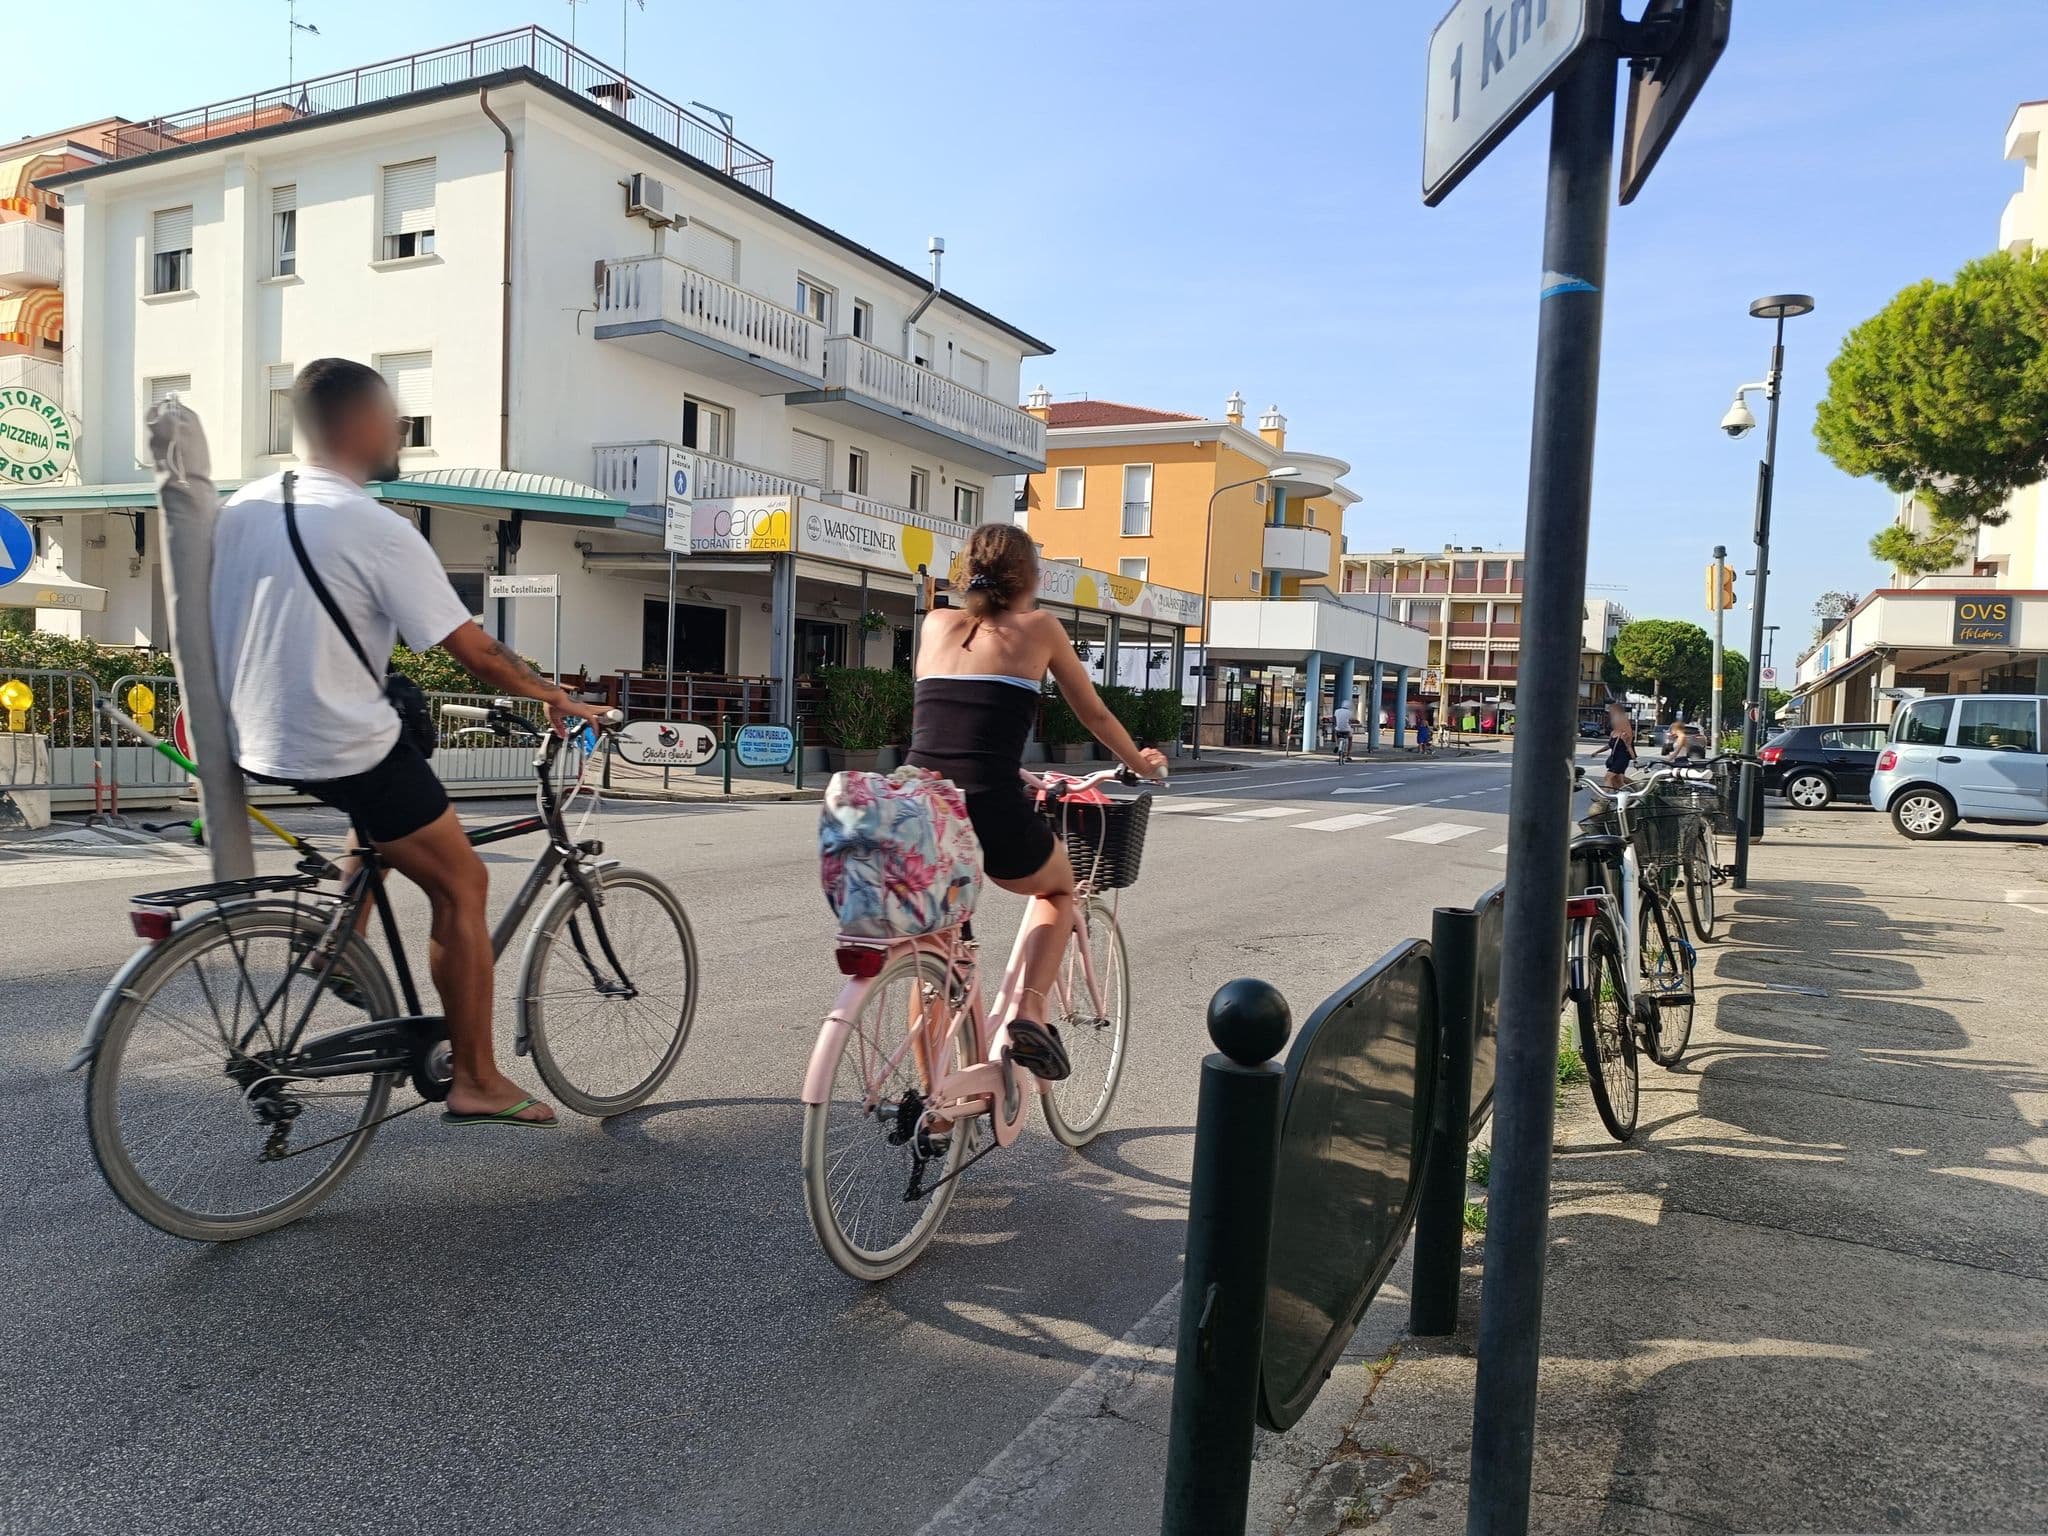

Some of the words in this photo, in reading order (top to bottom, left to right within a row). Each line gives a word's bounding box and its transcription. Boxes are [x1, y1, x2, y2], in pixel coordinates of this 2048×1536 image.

[1450, 42, 1463, 122] 1
[1481, 0, 1547, 91] km
[0, 422, 49, 450] PIZZERIA
[713, 508, 787, 542] paron
[823, 518, 896, 552] WARSTEINER
[744, 538, 787, 550] PIZZERIA
[493, 585, 509, 594] delle
[511, 585, 553, 594] Costellazioni
[1103, 582, 1135, 601] PIZZERIA
[1960, 603, 2007, 620] OVS
